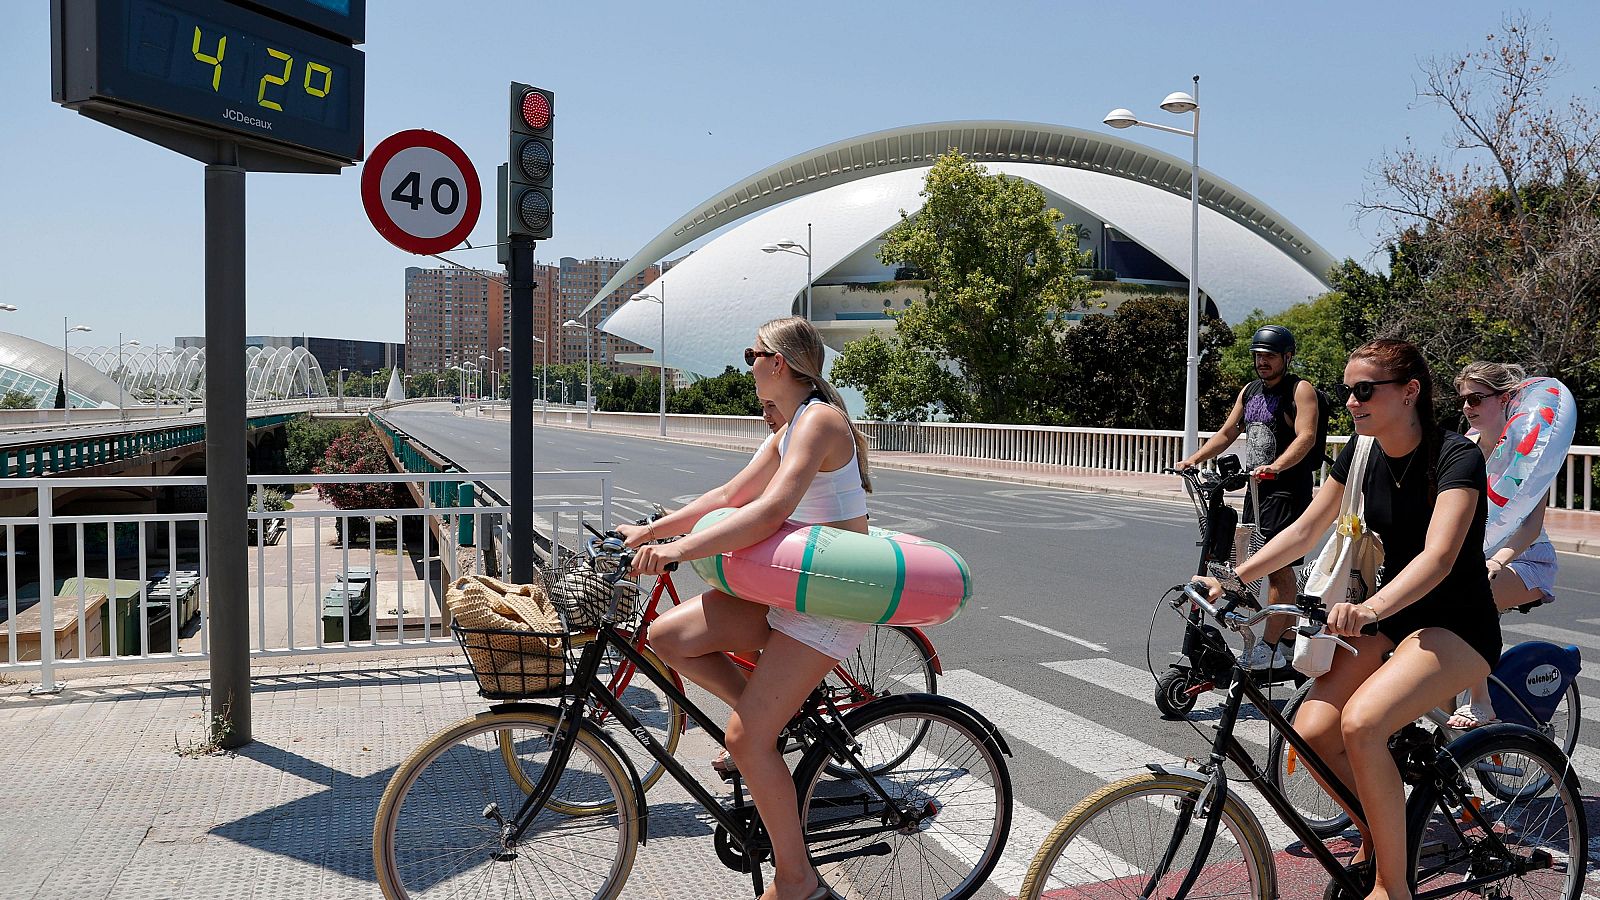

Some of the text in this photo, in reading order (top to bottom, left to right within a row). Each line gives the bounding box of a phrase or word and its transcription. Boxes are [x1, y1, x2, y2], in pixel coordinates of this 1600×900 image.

[222, 108, 273, 130] JCDecaux
[391, 171, 461, 216] 40
[1527, 668, 1559, 685] valenbisi
[631, 726, 651, 747] Kleta
